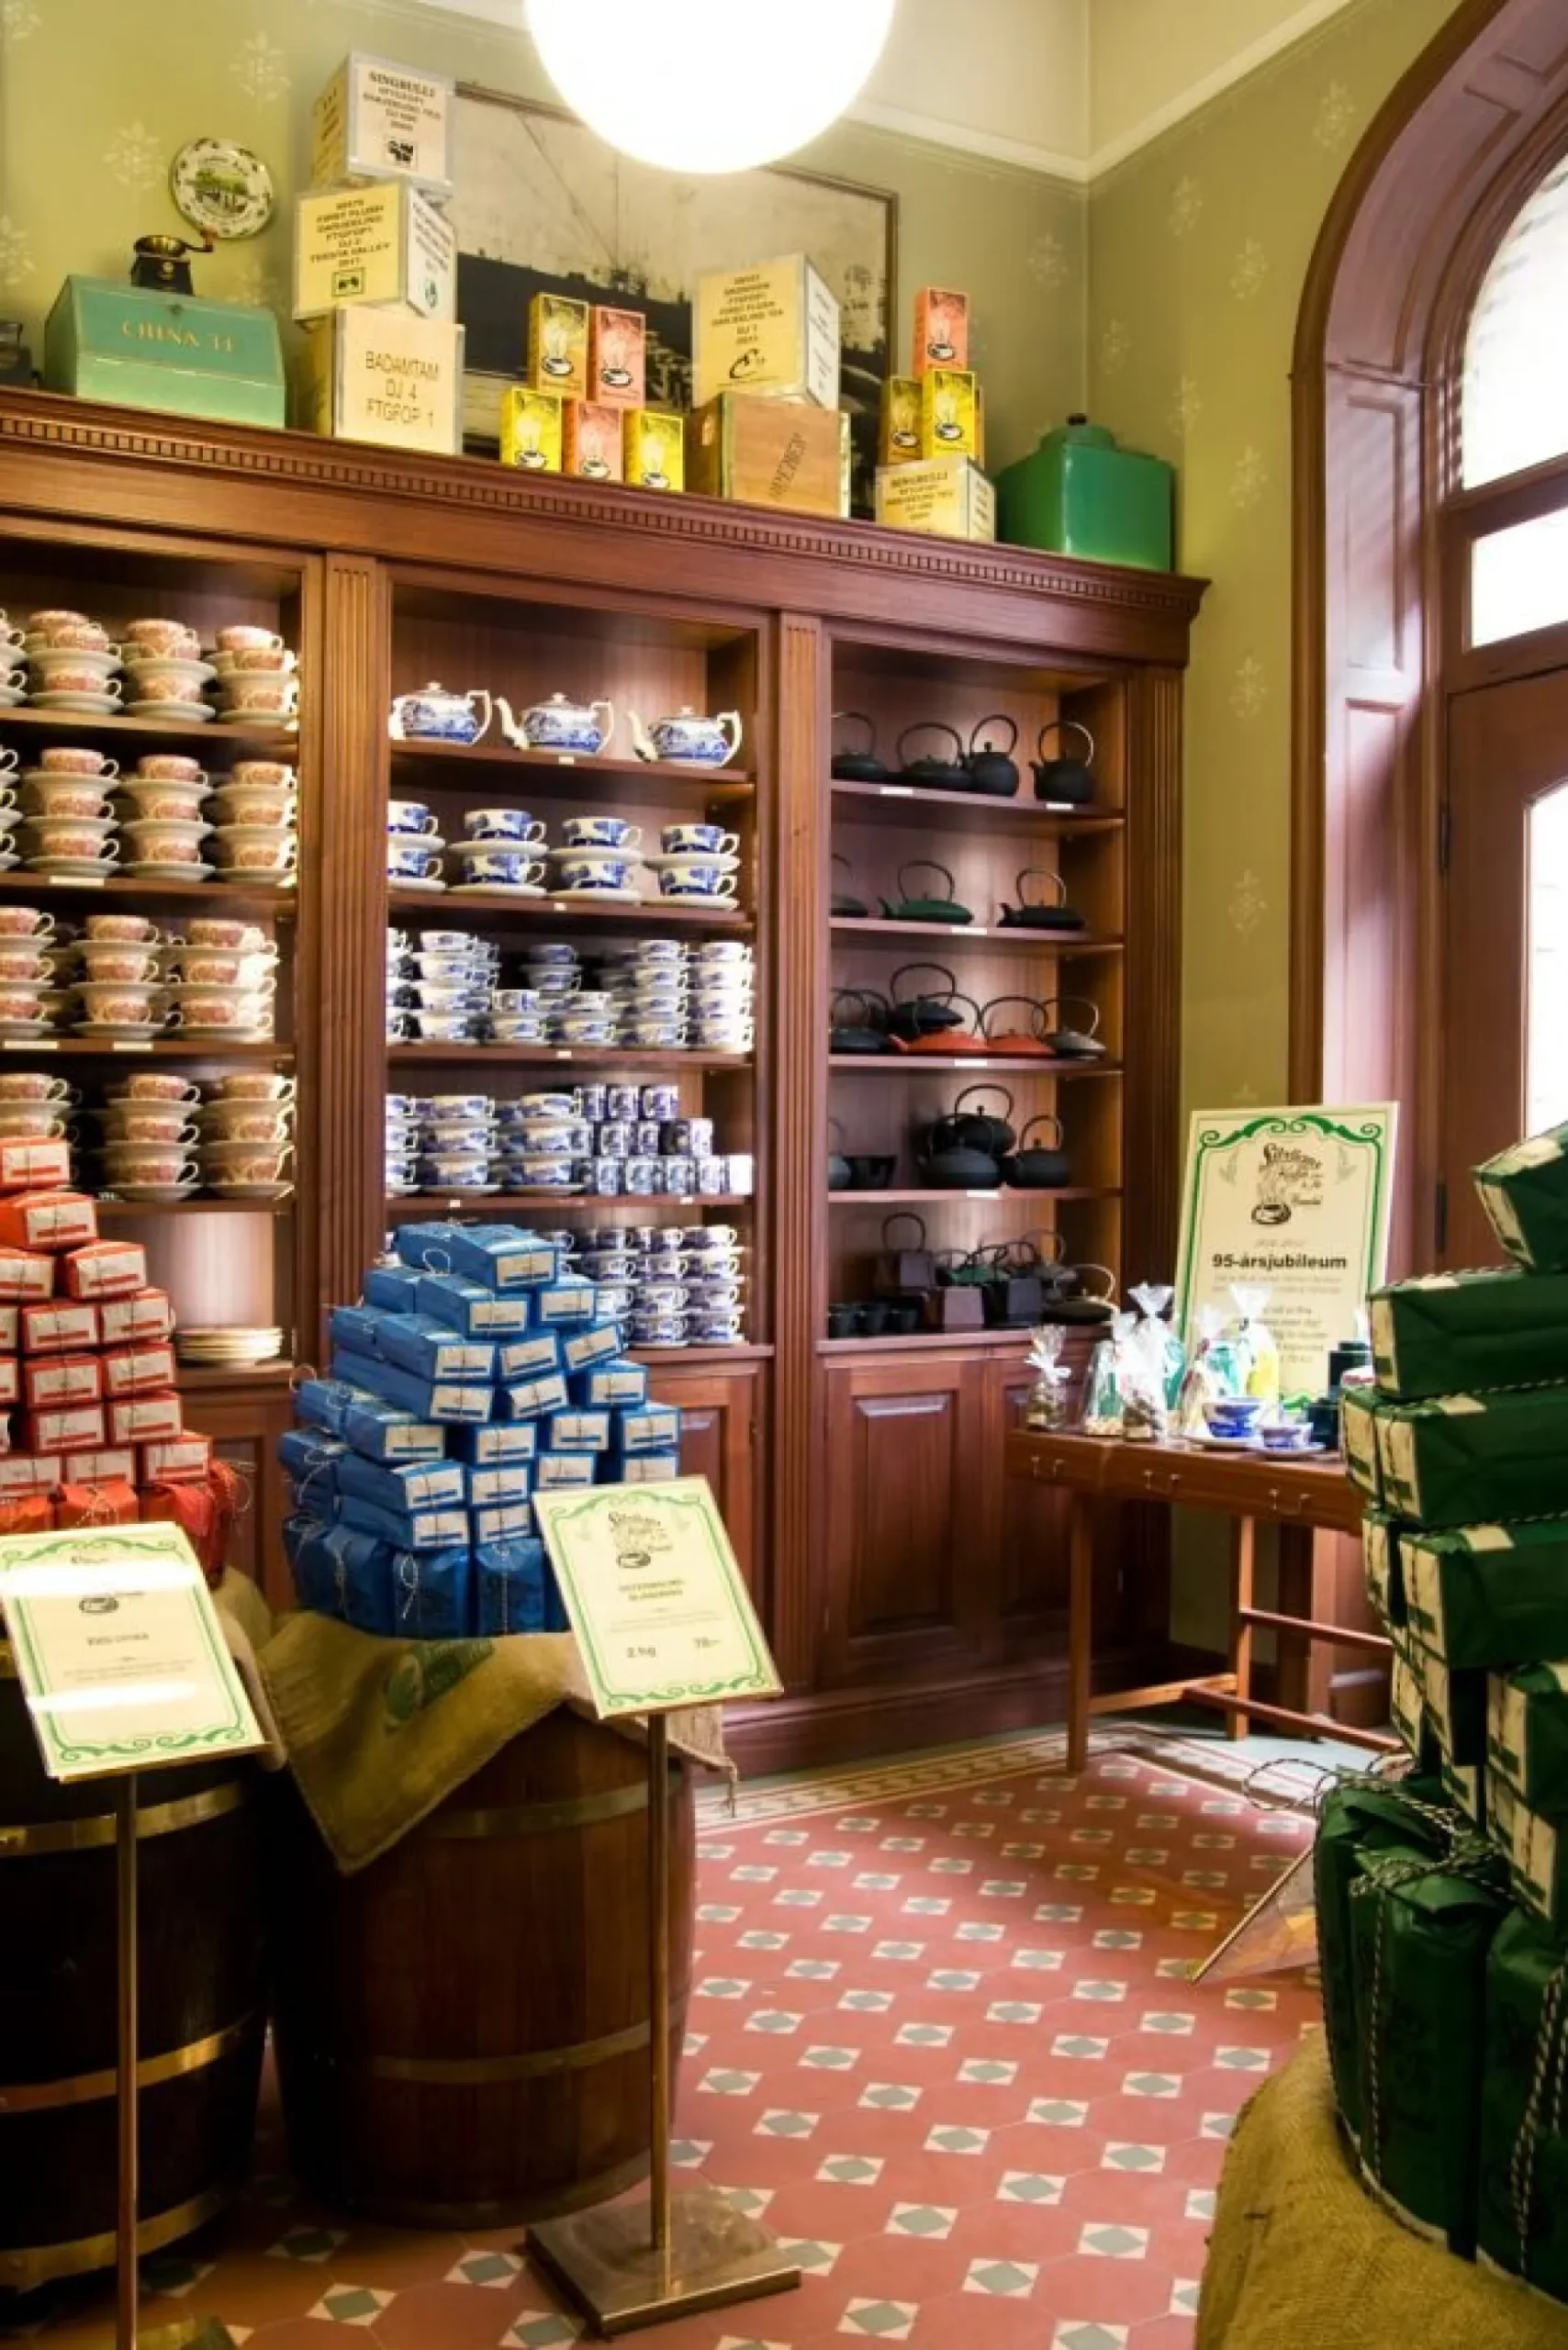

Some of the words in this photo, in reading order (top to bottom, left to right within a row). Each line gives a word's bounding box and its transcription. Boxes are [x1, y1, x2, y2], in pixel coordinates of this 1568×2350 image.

[121, 319, 201, 348] CHINA
[365, 350, 439, 381] BADAMTAM
[386, 377, 403, 398] DJ
[408, 382, 418, 402] 4
[365, 397, 421, 425] FTGFOP
[1211, 1252, 1348, 1272] 95-årsjubileum
